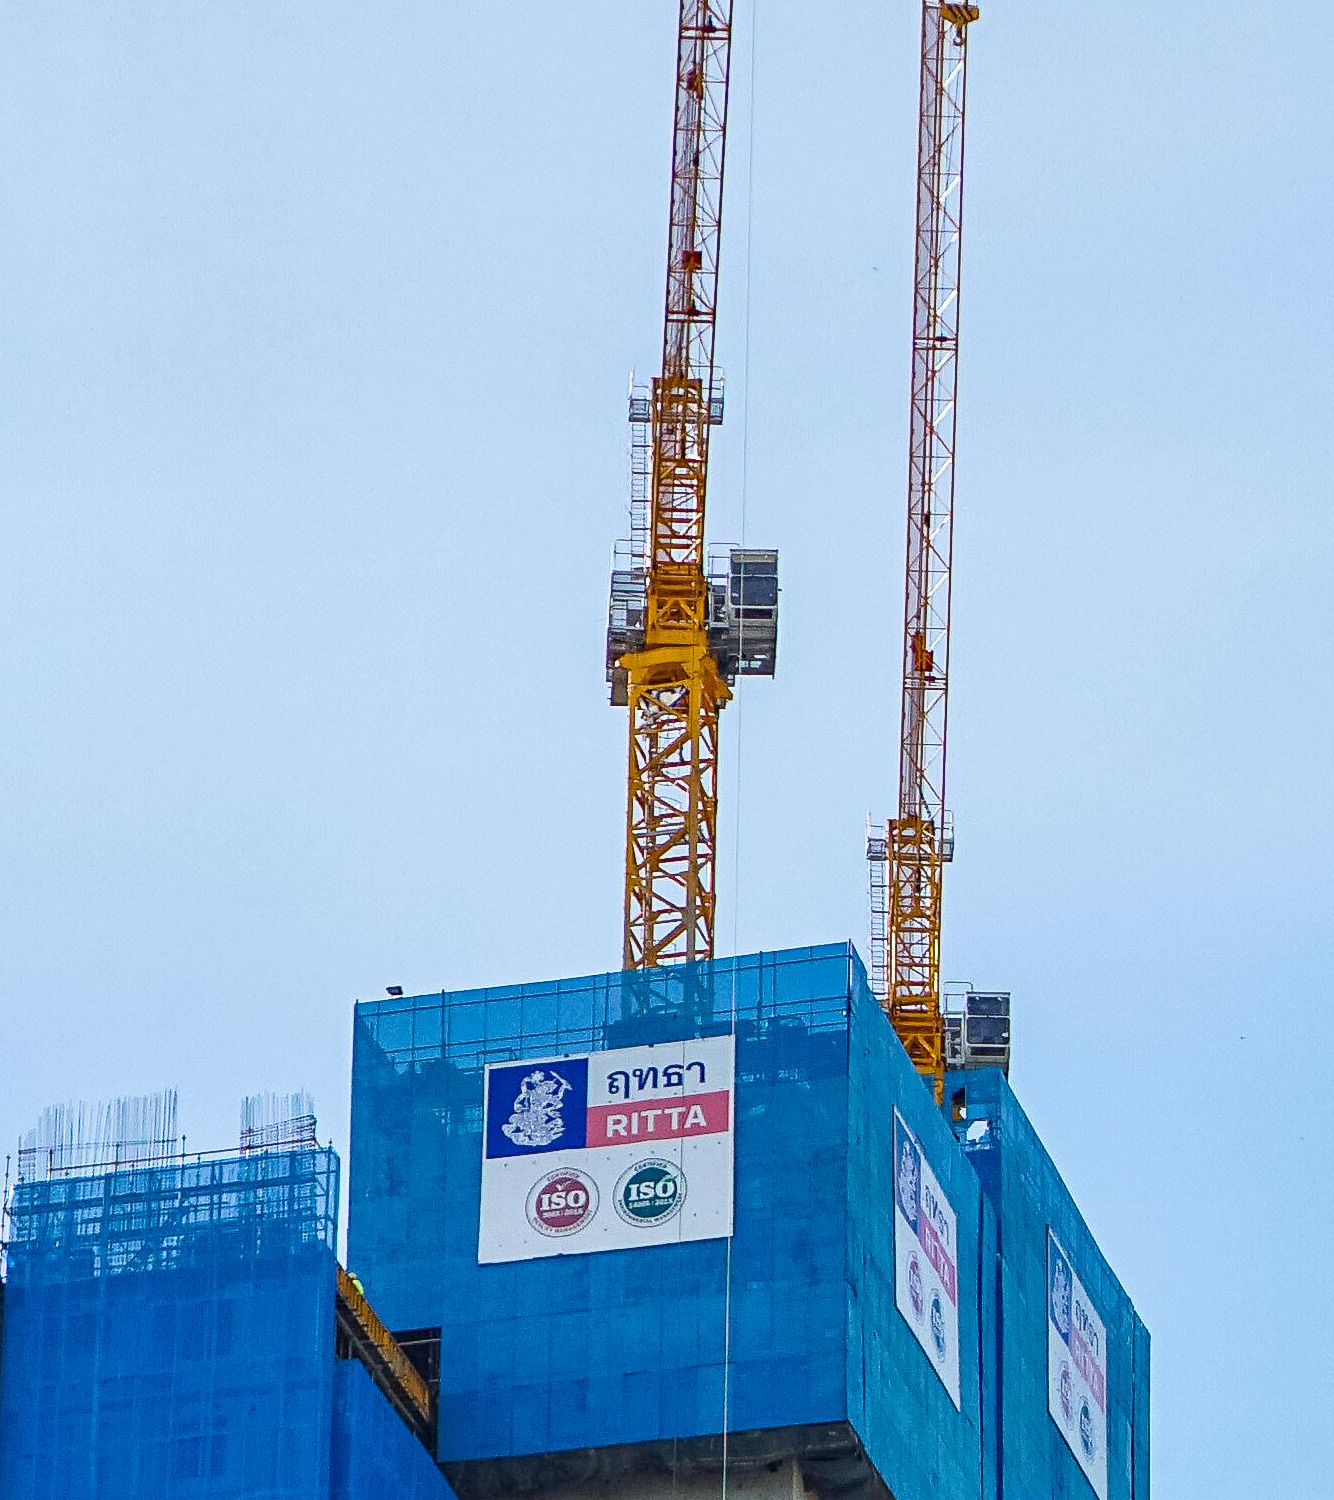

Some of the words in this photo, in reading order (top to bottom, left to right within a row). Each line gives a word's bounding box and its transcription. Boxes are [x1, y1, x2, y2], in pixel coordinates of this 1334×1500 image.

[606, 1060, 707, 1100] ฤทธา
[605, 1104, 708, 1138] RITTA
[539, 1189, 587, 1211] ISO
[627, 1179, 676, 1202] ISO
